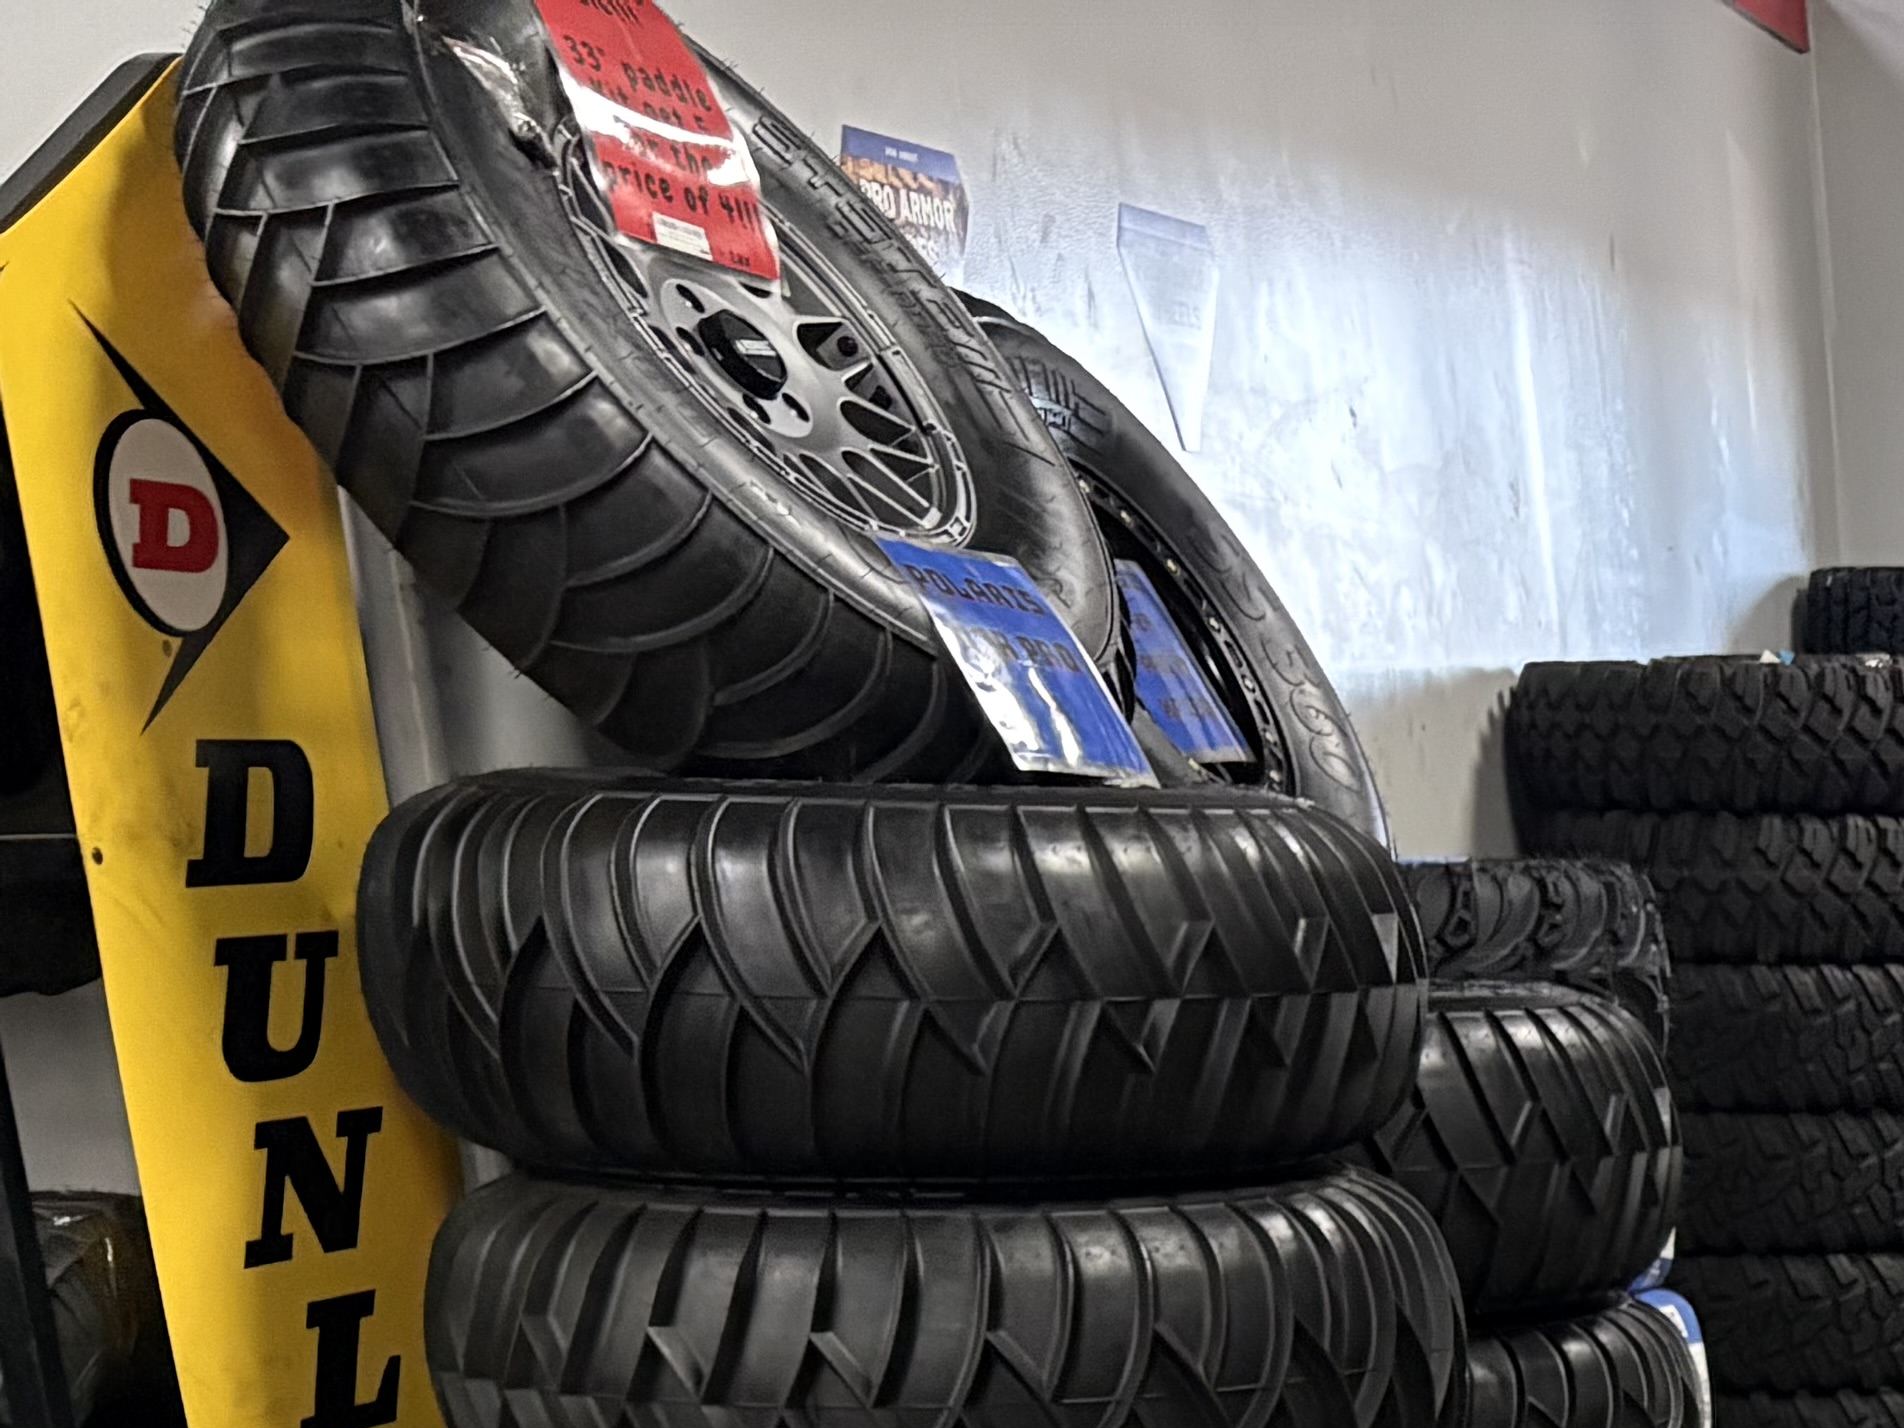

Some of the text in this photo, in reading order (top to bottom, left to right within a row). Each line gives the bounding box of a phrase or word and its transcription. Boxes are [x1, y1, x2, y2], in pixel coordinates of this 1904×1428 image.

[621, 62, 713, 112] paddle
[603, 159, 674, 204] price
[684, 185, 709, 225] of
[899, 188, 956, 233] ARMOR
[129, 478, 219, 573] D
[904, 564, 1046, 616] POLARIS
